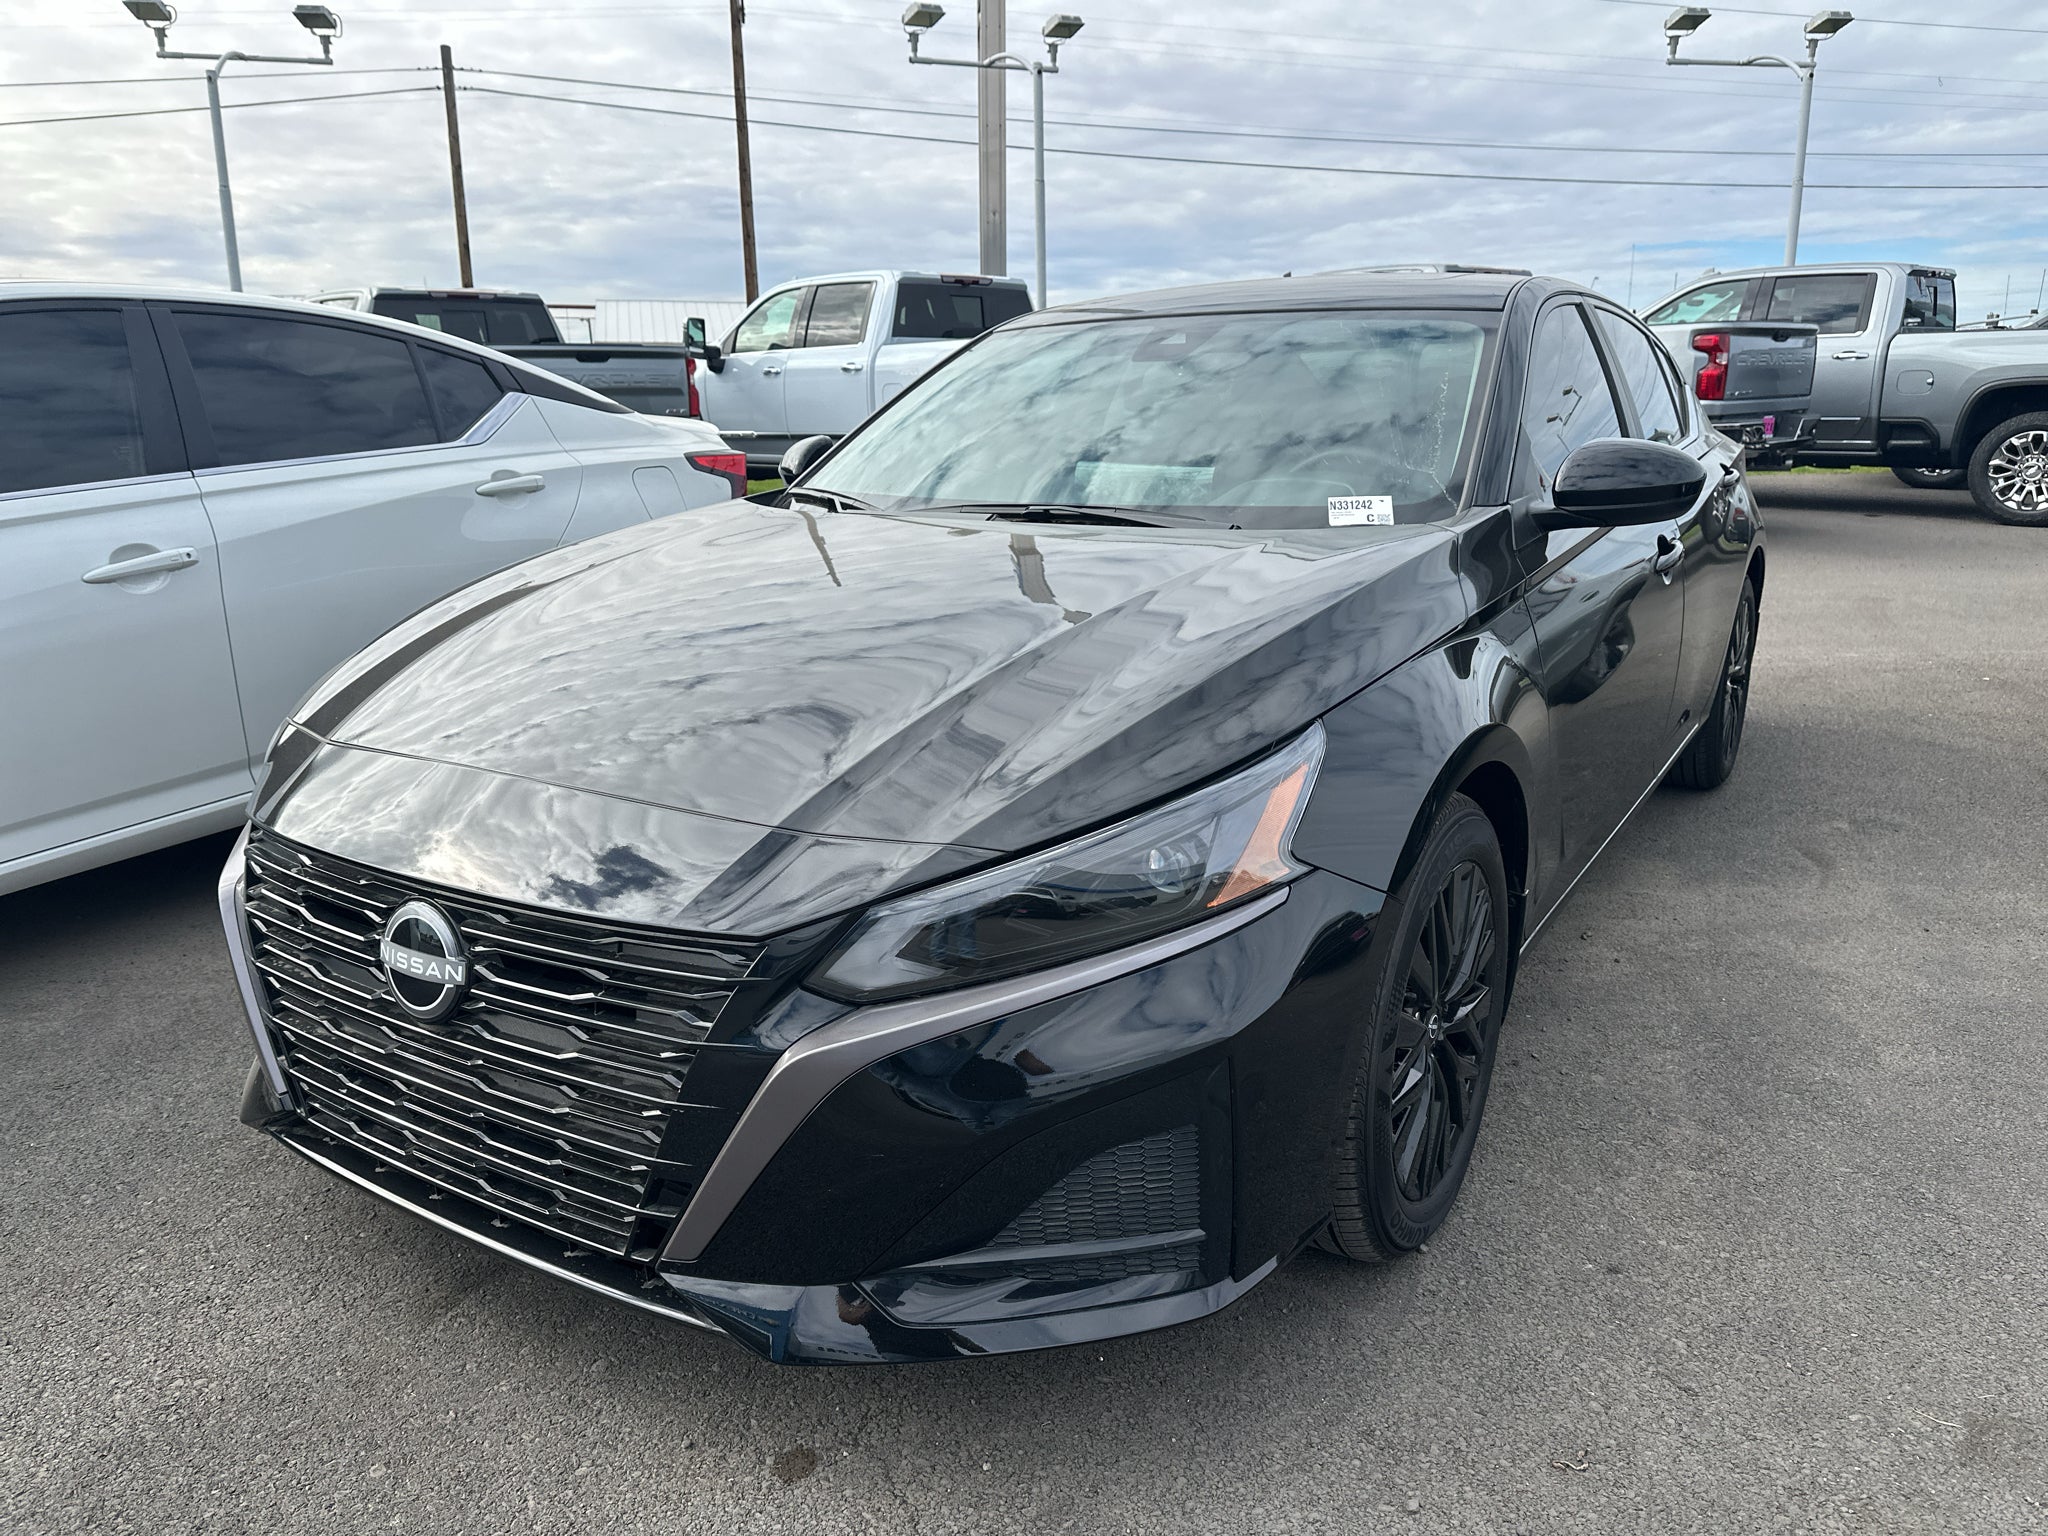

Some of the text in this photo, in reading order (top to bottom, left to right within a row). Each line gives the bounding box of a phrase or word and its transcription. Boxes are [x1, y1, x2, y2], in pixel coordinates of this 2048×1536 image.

[1736, 352, 1813, 366] CHEVROLET
[1329, 499, 1373, 511] N331242
[1366, 513, 1375, 523] C
[380, 943, 463, 982] NISSAN
